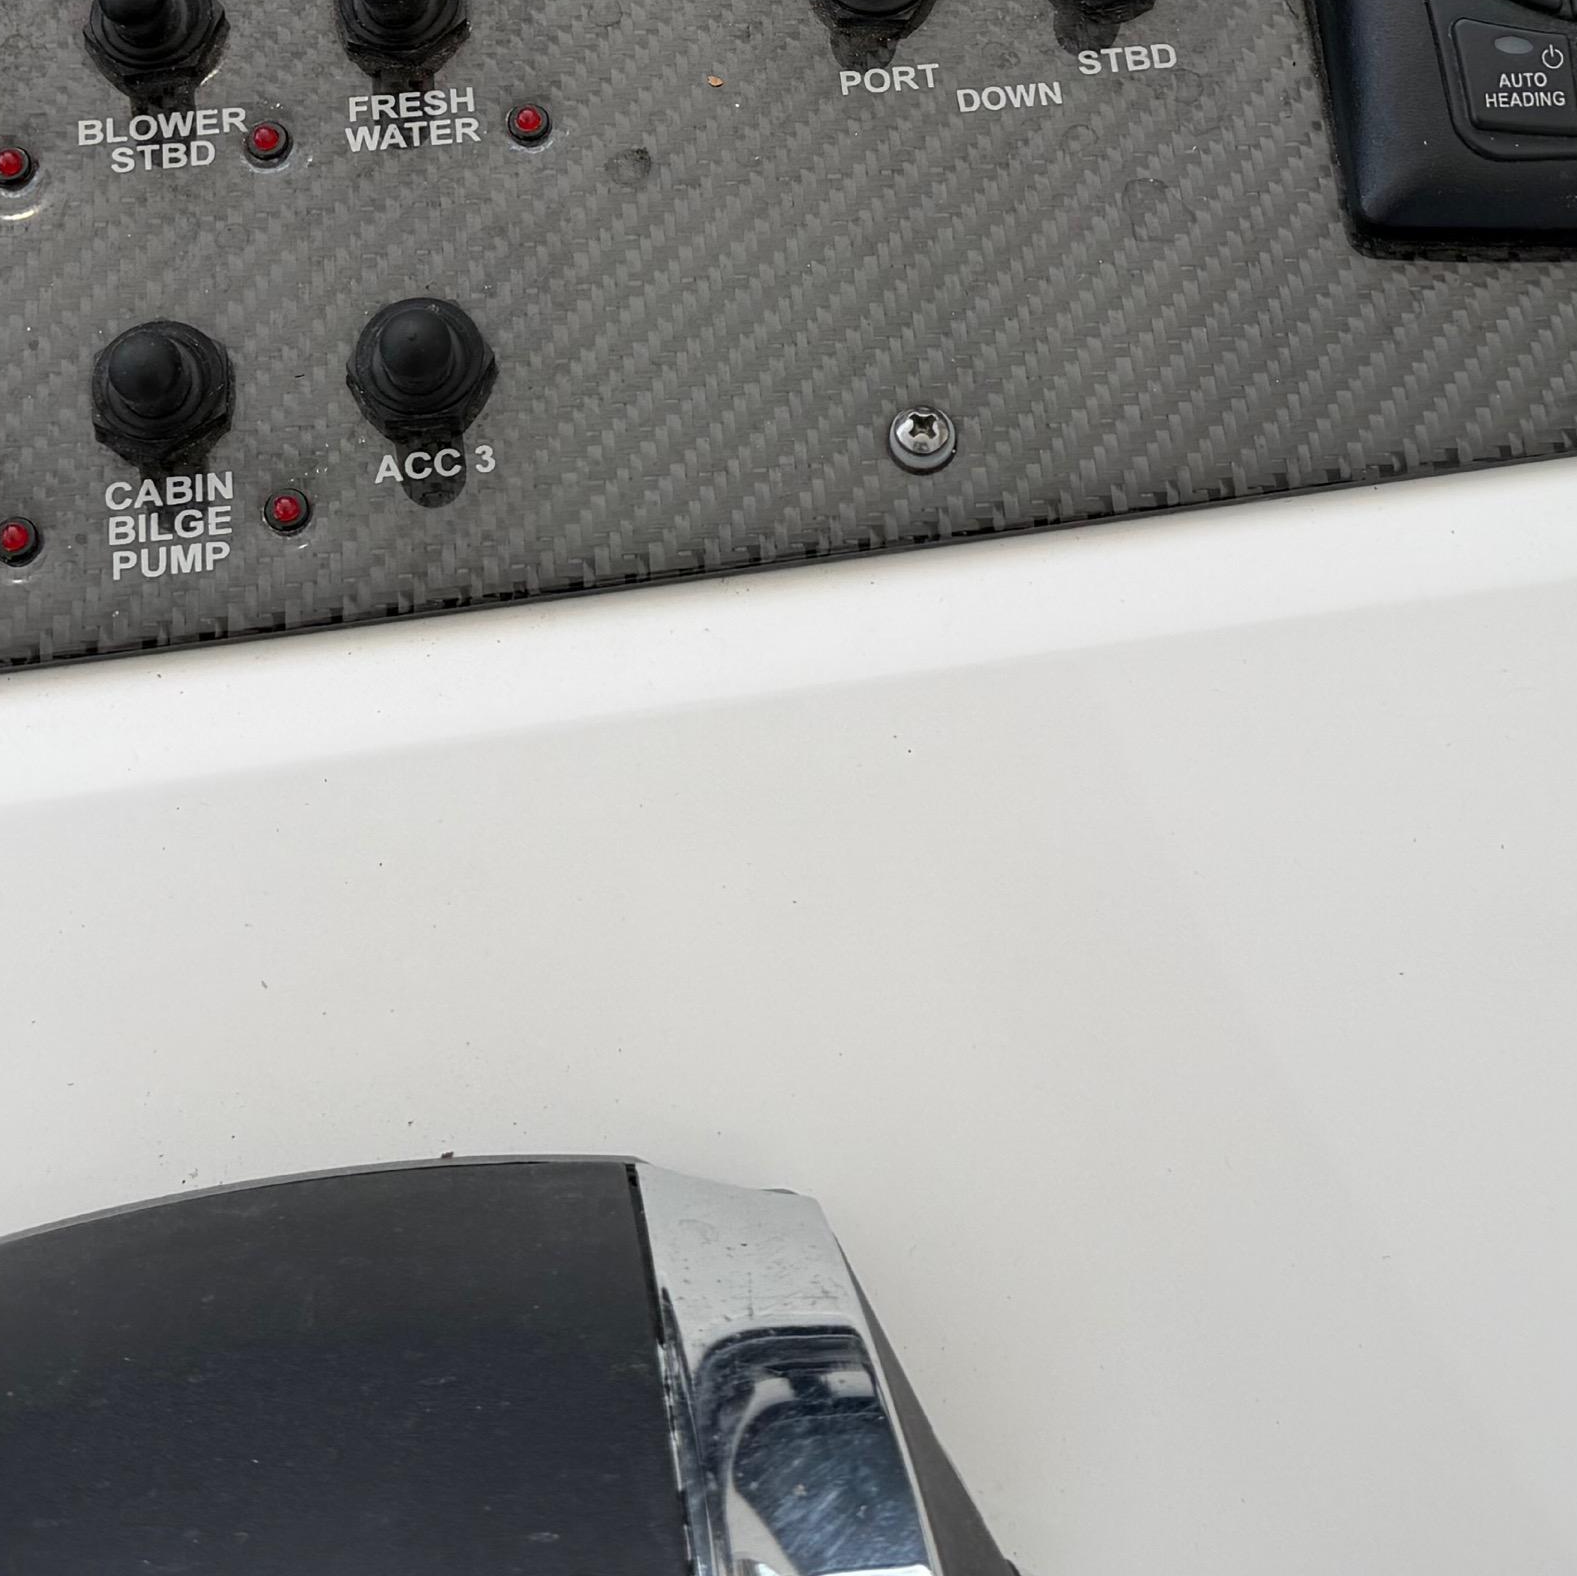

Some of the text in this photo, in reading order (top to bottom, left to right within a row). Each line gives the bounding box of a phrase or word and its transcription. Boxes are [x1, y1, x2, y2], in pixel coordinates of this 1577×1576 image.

[1077, 42, 1178, 76] STBD
[838, 62, 940, 96] PORT
[956, 80, 1064, 114] DOWN
[1498, 71, 1548, 89] AUTO
[347, 86, 477, 123] FRESH
[1484, 90, 1567, 109] HEADING
[76, 107, 248, 147] BLOWER
[344, 116, 482, 153] WATER
[110, 141, 217, 175] STBD
[373, 445, 498, 484] ACC 3
[104, 471, 236, 511] CABIN
[106, 505, 234, 547] BILGE
[111, 540, 231, 581] PUMP
